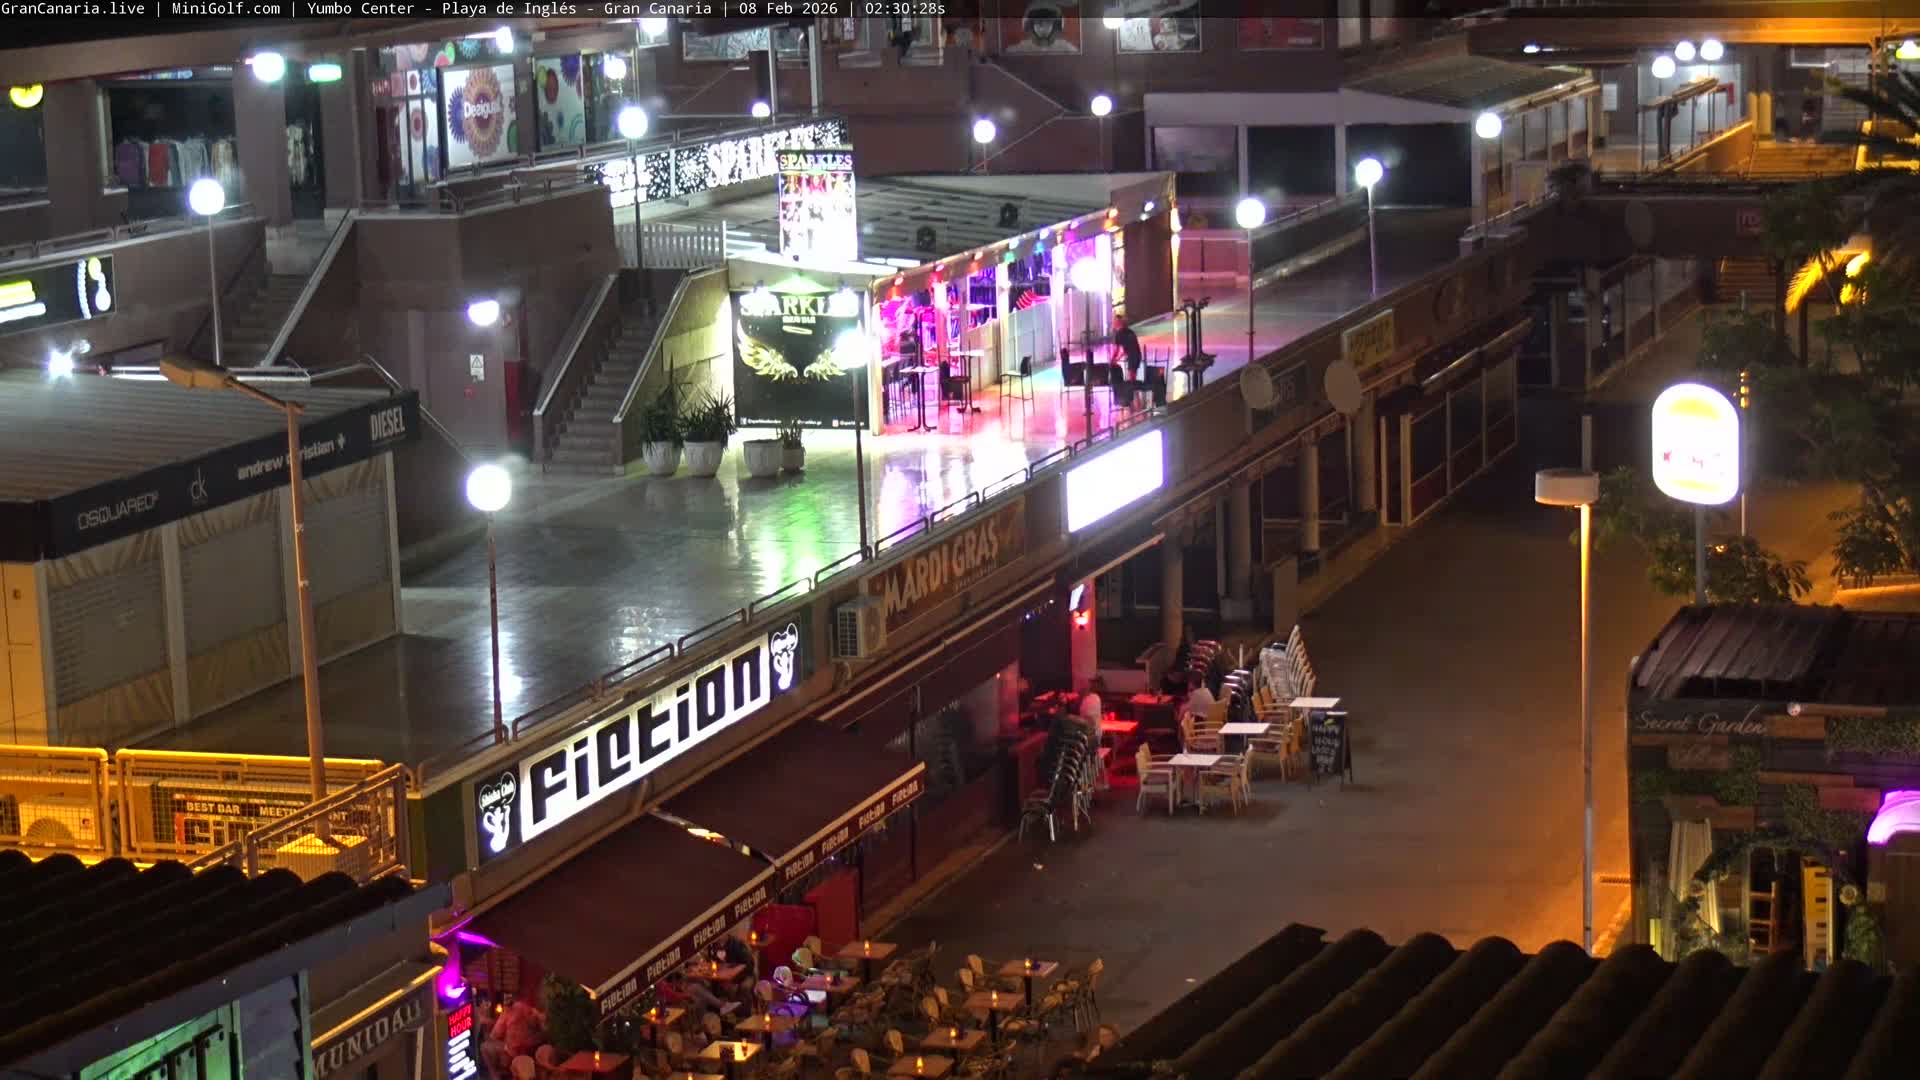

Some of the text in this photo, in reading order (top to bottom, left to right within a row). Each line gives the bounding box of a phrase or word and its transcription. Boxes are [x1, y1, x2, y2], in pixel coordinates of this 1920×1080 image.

[464, 101, 500, 119] Desigu
[779, 154, 853, 170] SPARKLES
[370, 405, 406, 441] DIESEL
[237, 439, 335, 481] andrew cristian
[885, 543, 948, 617] MARDI
[952, 519, 999, 577] GRAS
[1638, 704, 1769, 737] Secret Garden
[529, 644, 763, 827] Fiction
[186, 801, 217, 813] BEST
[217, 803, 241, 815] BAR
[449, 1003, 472, 1027] HAPPY
[450, 1016, 473, 1039] HOUR
